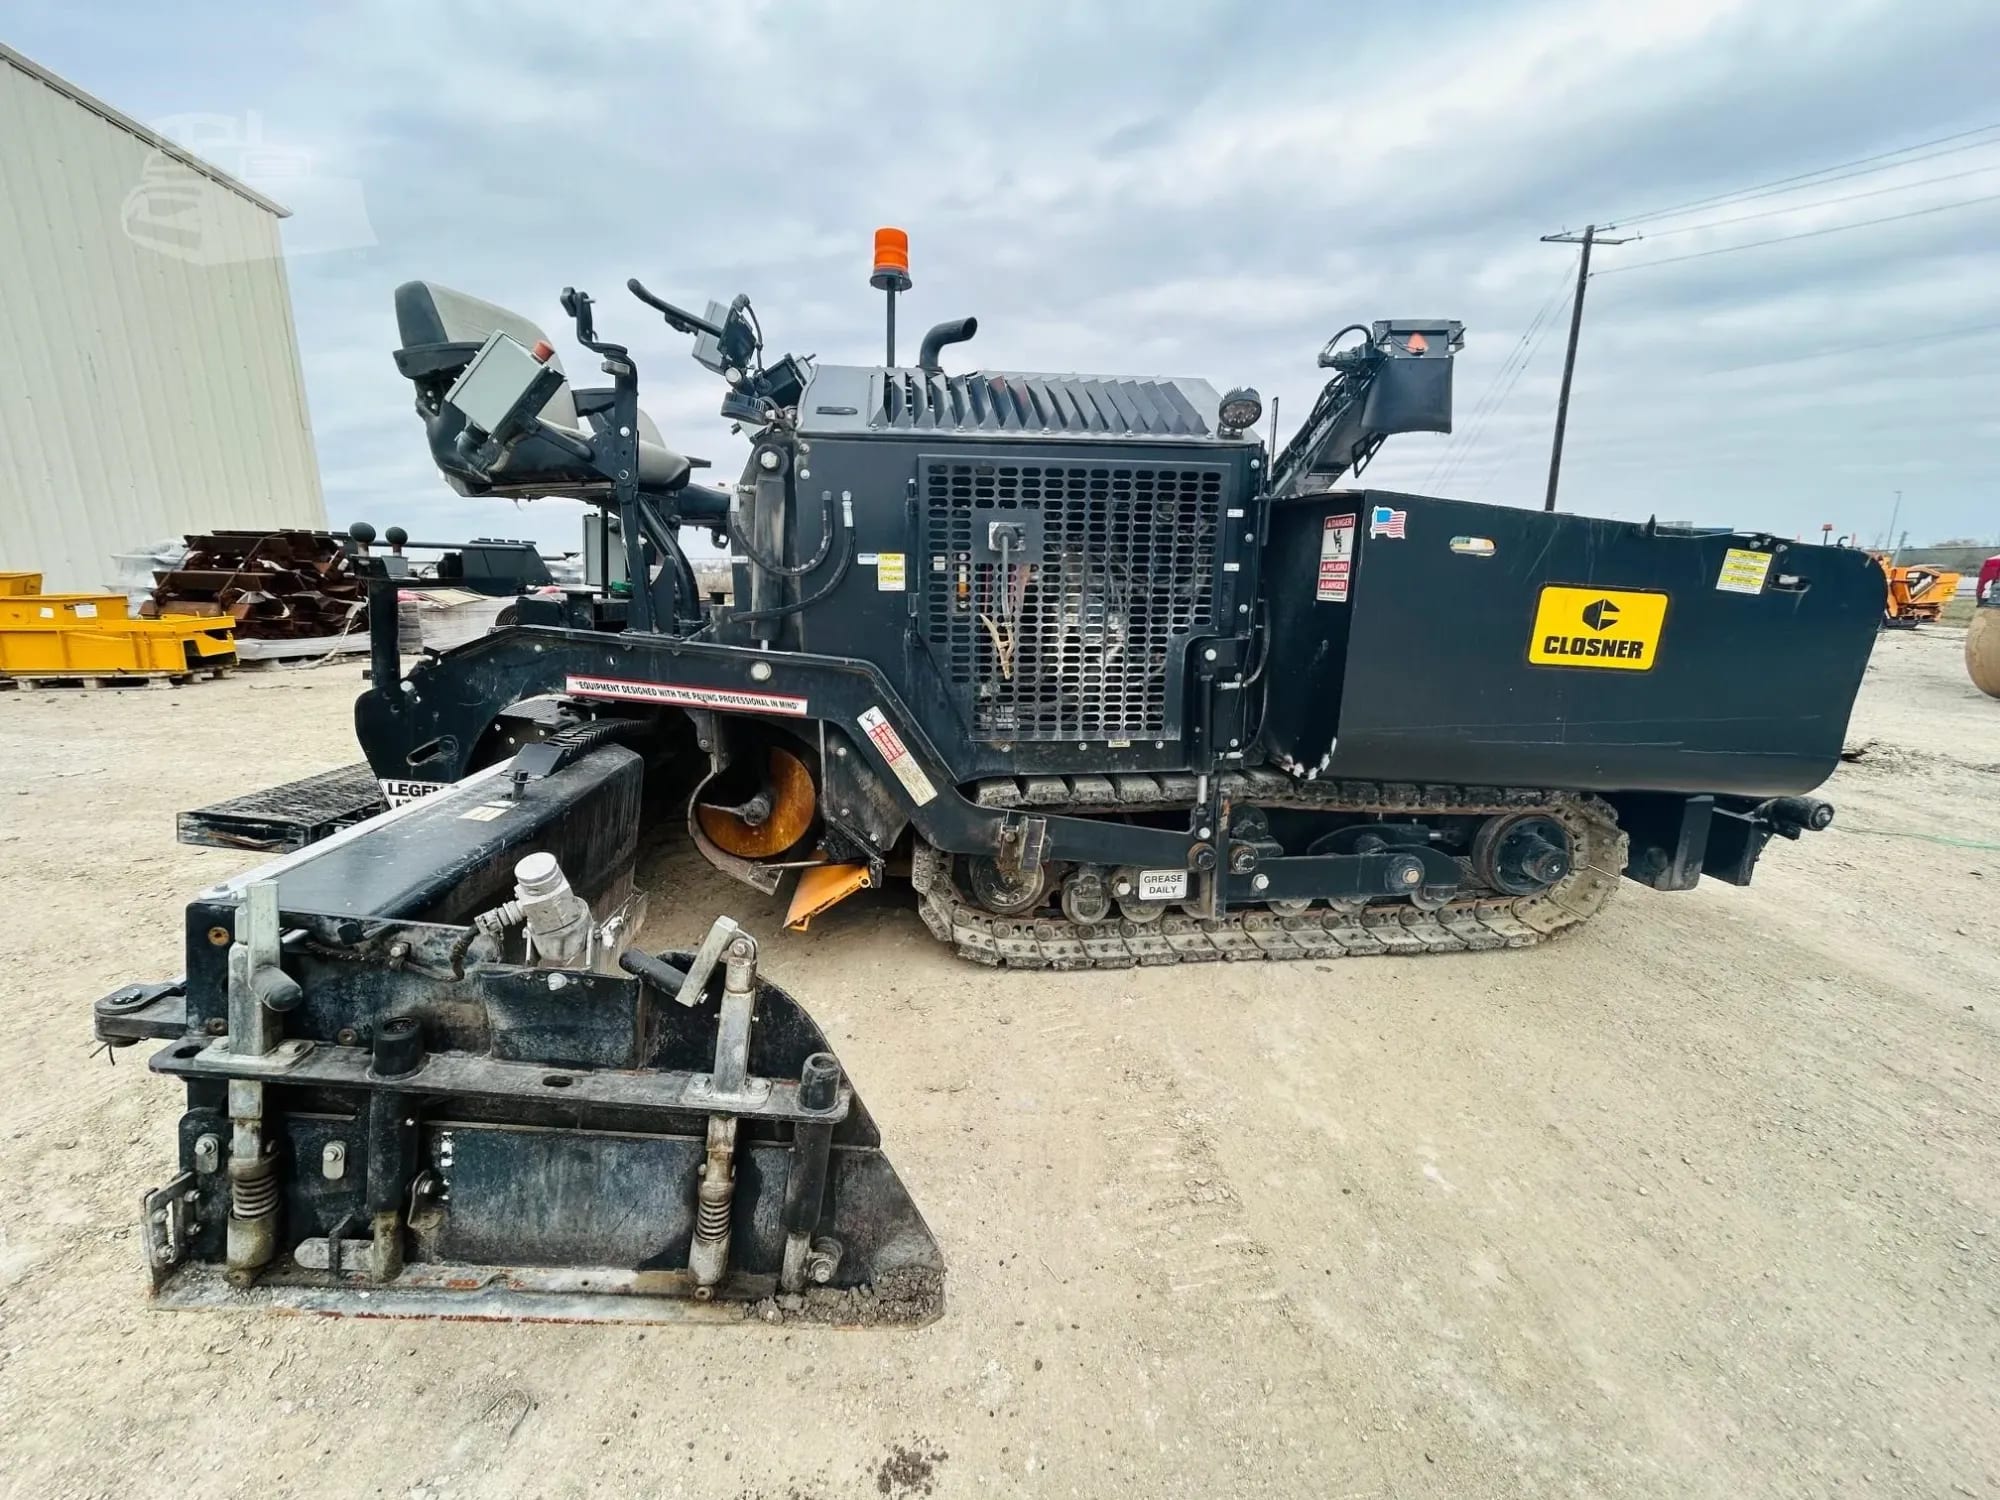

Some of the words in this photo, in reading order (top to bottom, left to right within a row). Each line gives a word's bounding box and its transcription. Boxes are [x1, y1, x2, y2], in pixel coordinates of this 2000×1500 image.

[1543, 635, 1644, 659] CLOSNER
[621, 685, 657, 696] DESIGNED
[657, 689, 676, 698] WITH
[676, 690, 692, 700] THE
[719, 694, 770, 707] PROFESSIONAL
[770, 699, 779, 708] IN
[1144, 874, 1183, 884] GREASE
[1149, 886, 1177, 894] DAILY
